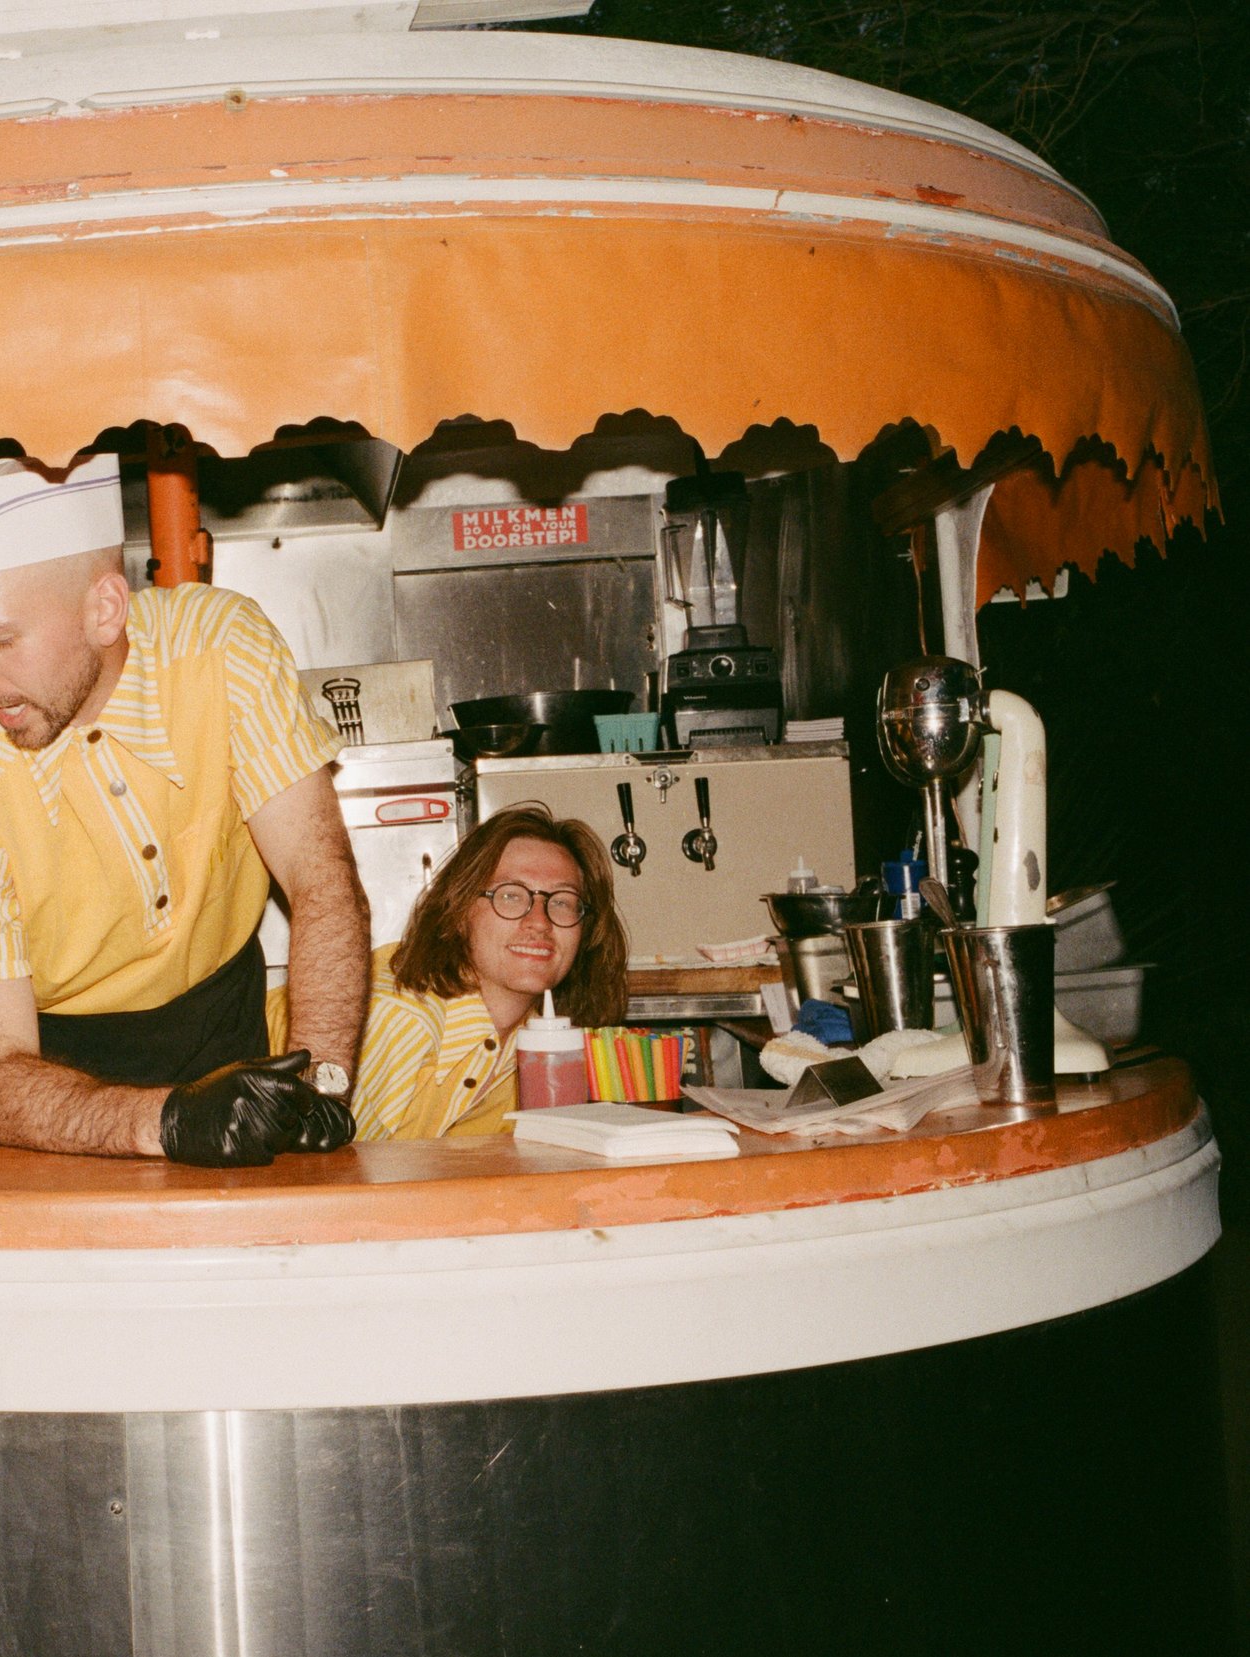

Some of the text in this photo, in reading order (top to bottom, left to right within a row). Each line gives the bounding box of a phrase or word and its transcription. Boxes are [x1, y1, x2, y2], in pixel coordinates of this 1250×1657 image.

[462, 506, 576, 526] MILKMEN
[463, 520, 576, 535] DO IT ON YOUR
[463, 530, 577, 549] DOORSTEP!
